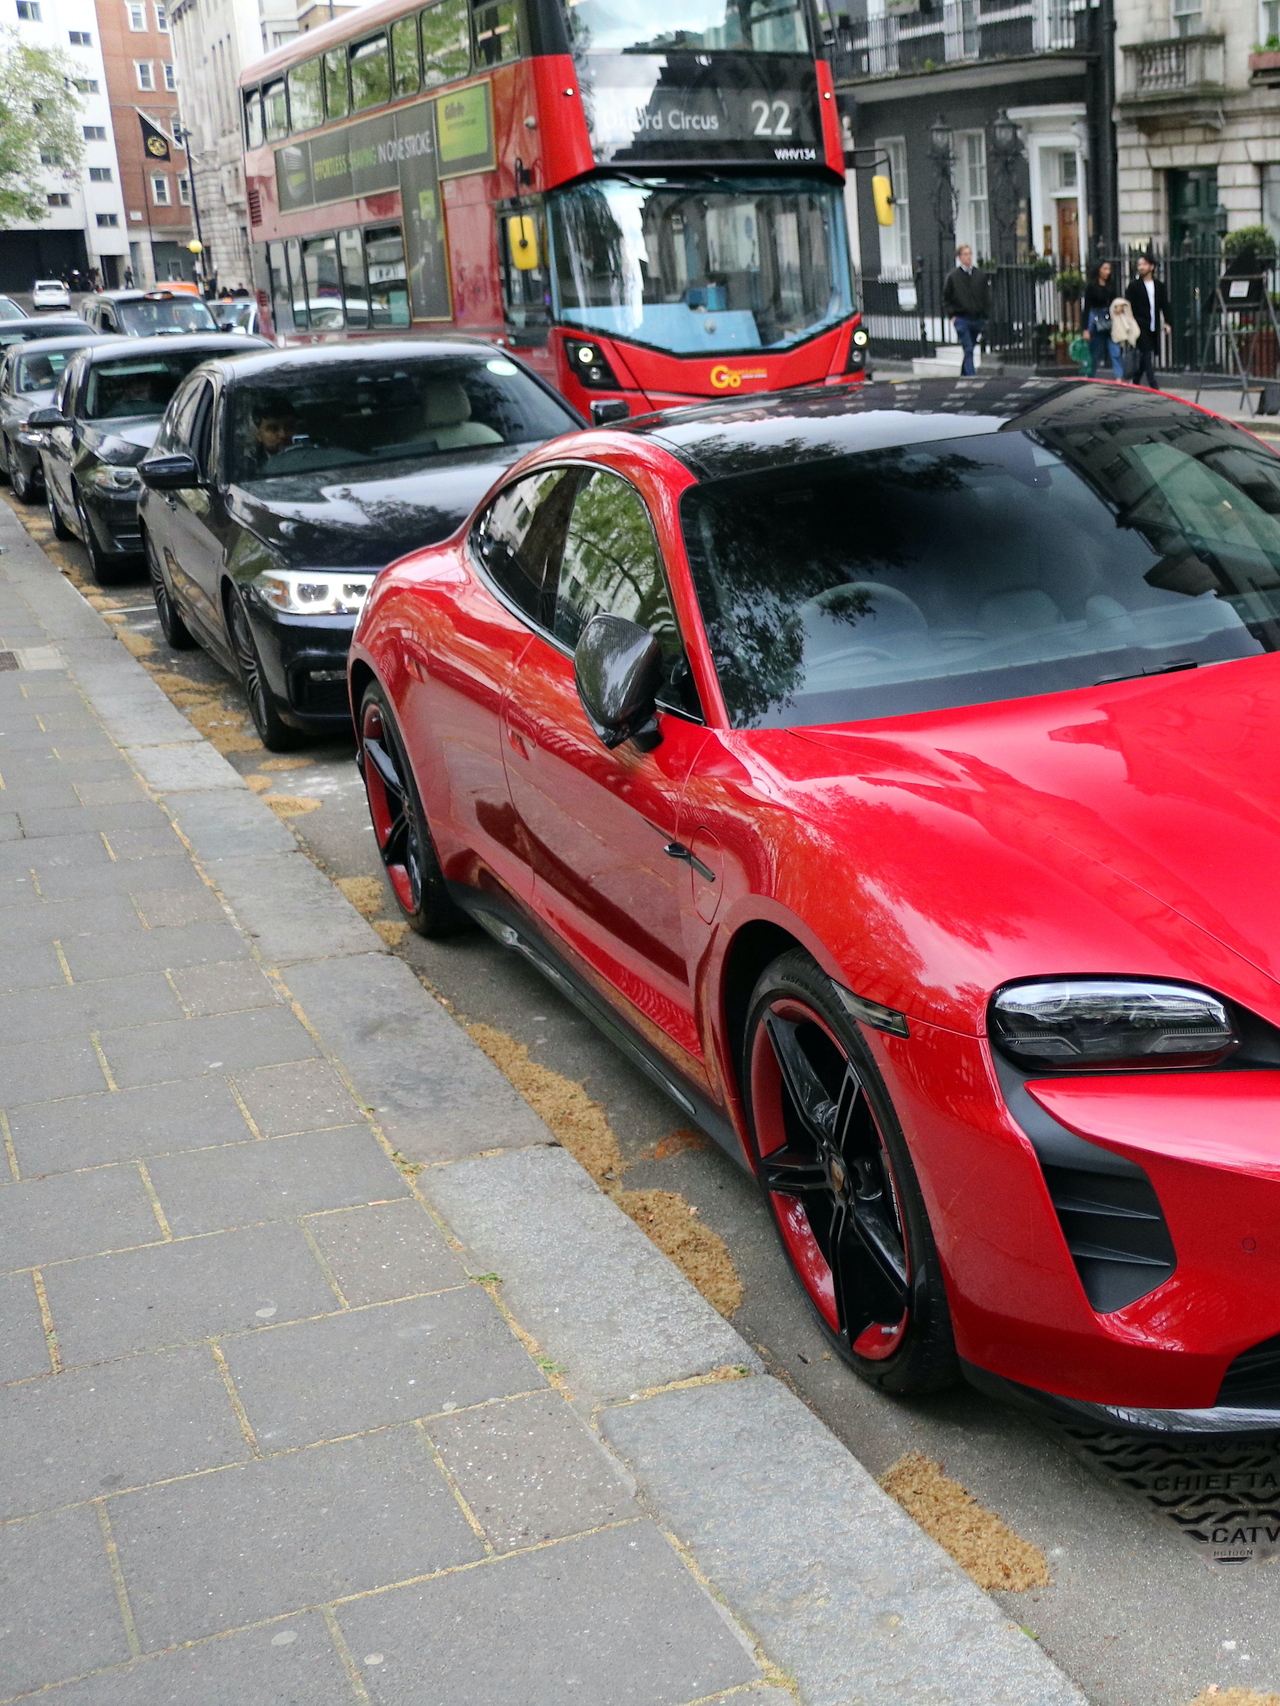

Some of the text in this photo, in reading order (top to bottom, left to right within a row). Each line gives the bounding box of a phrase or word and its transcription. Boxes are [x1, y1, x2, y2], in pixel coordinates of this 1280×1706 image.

[668, 109, 719, 130] Circus
[751, 99, 793, 136] 22
[774, 148, 816, 160] WHV134
